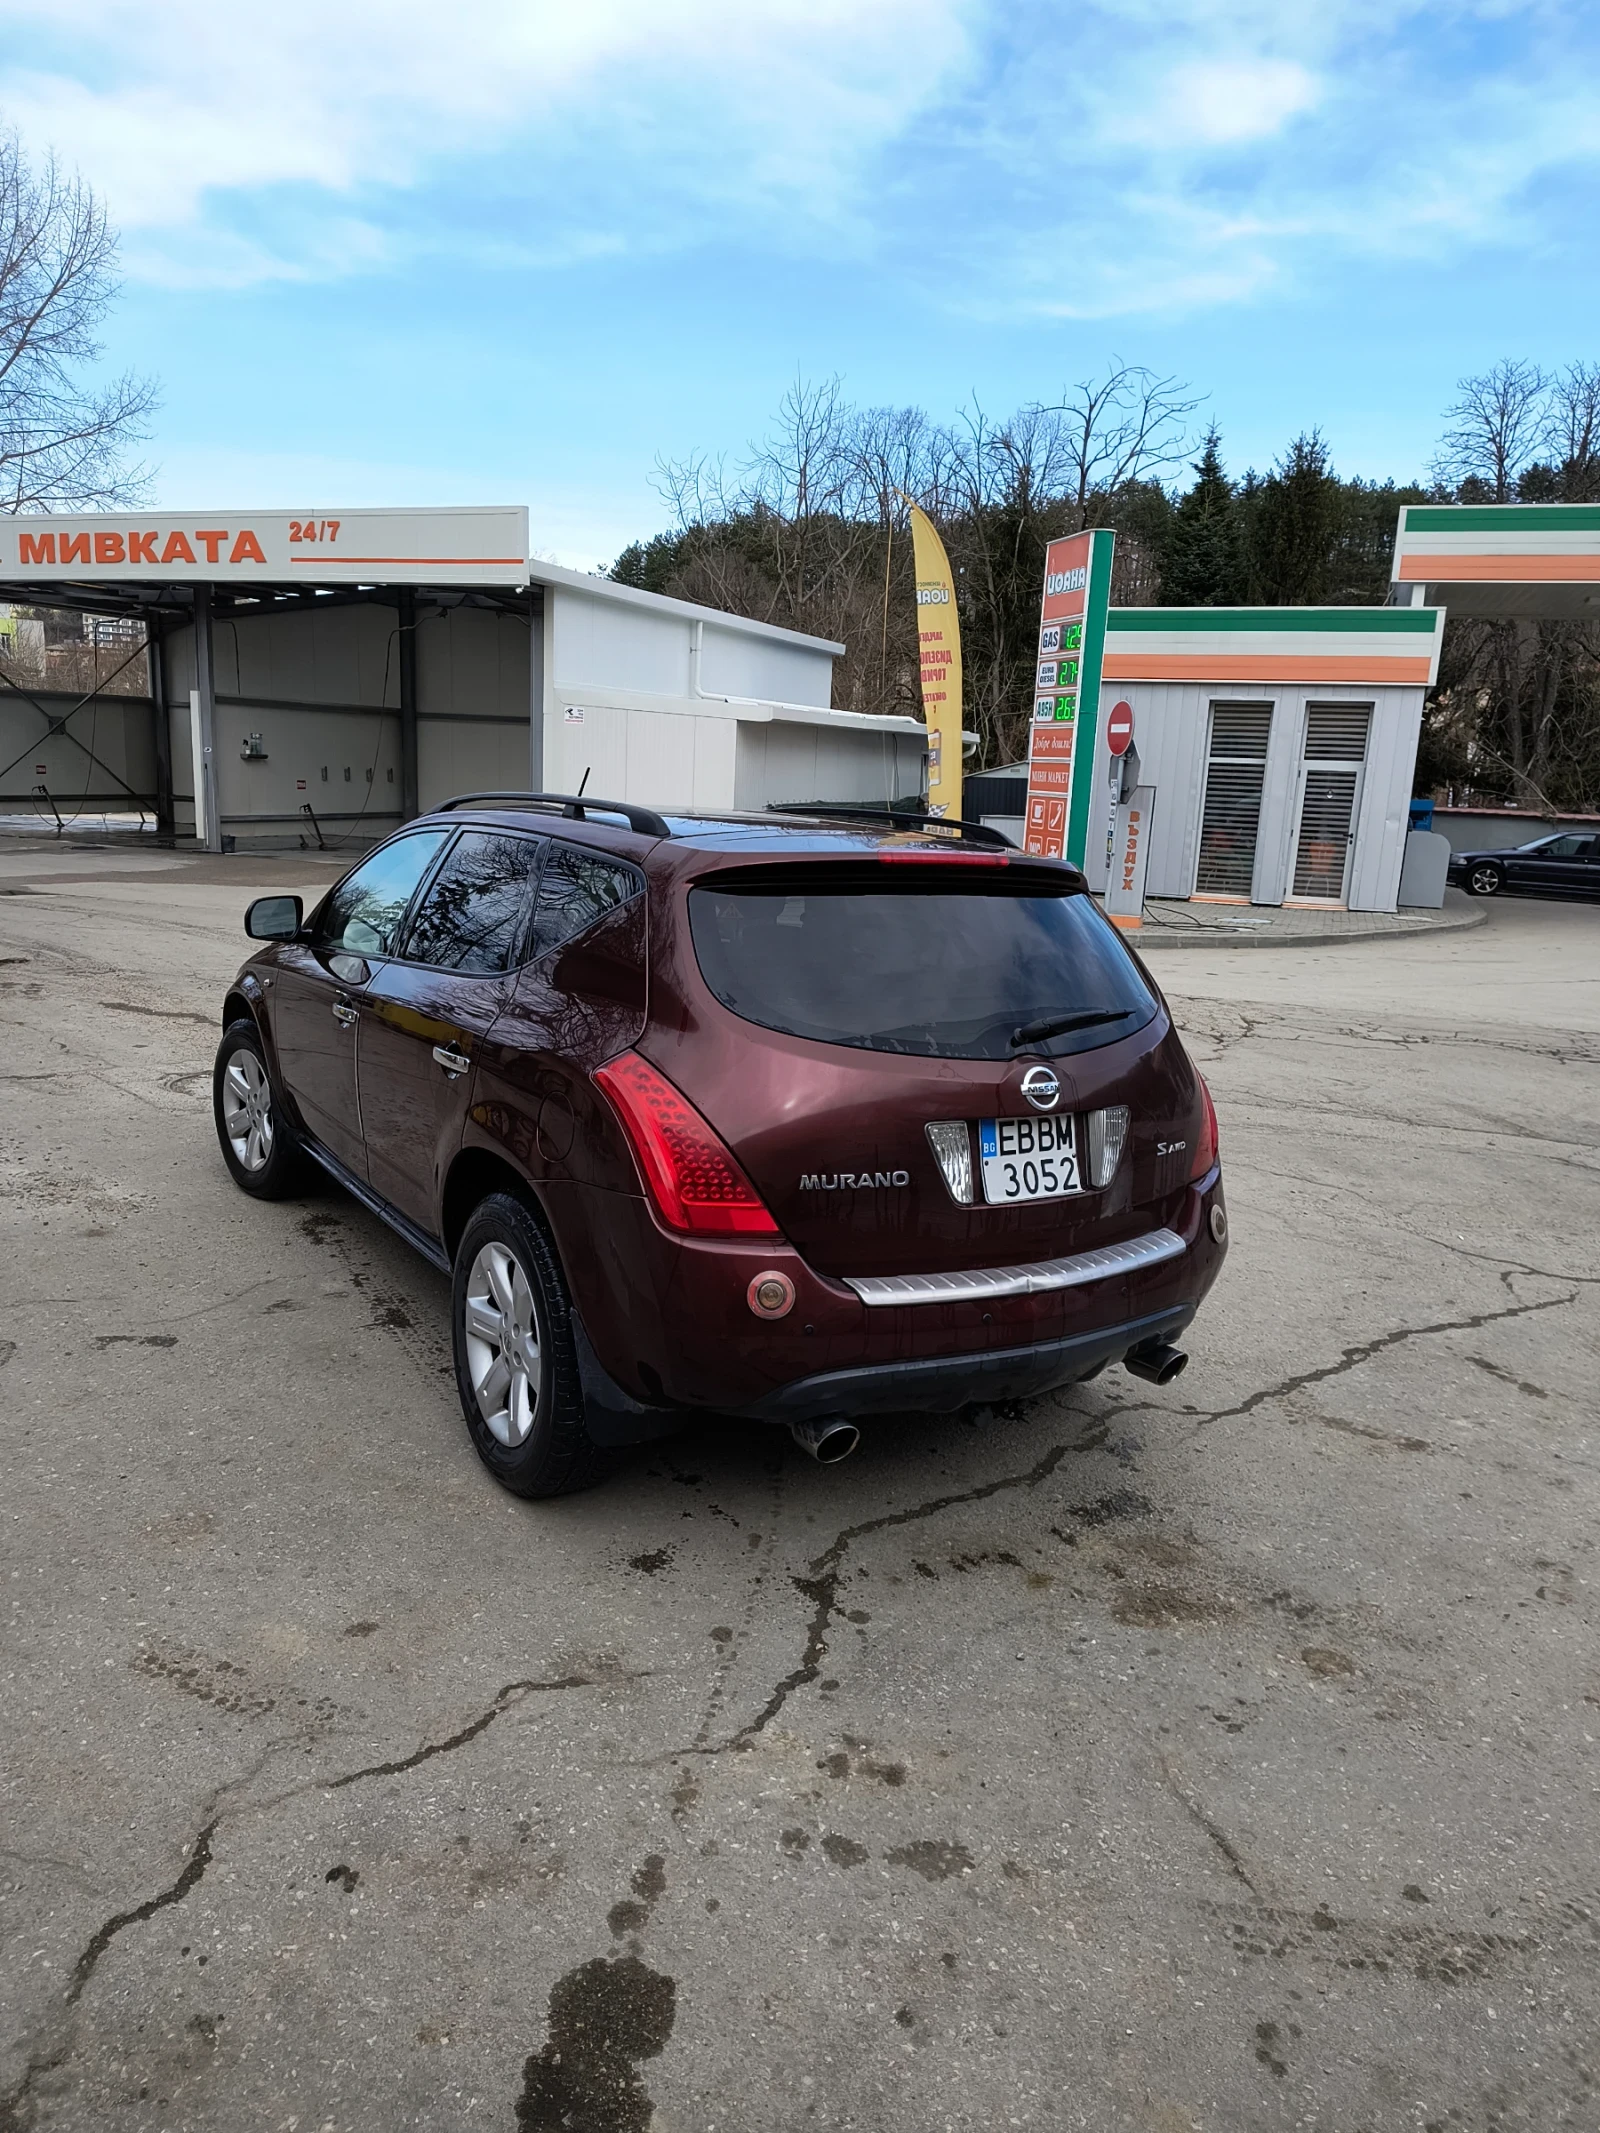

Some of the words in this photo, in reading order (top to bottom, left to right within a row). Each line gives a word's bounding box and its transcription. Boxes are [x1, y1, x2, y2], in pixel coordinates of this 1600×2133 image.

[18, 530, 267, 564] МИВКАТА
[289, 520, 341, 542] 24/7
[1042, 630, 1059, 649] GAS
[1039, 675, 1055, 683] DIESEL
[1042, 666, 1055, 675] EURO
[1047, 771, 1070, 784] МАРКЕТ
[1122, 811, 1141, 891] ВЪЗДУХ
[1027, 1084, 1060, 1093] NISSAN
[983, 1142, 996, 1154] BG
[998, 1114, 1074, 1156] EBBM
[799, 1170, 910, 1191] MURANO
[1003, 1156, 1079, 1198] 3052
